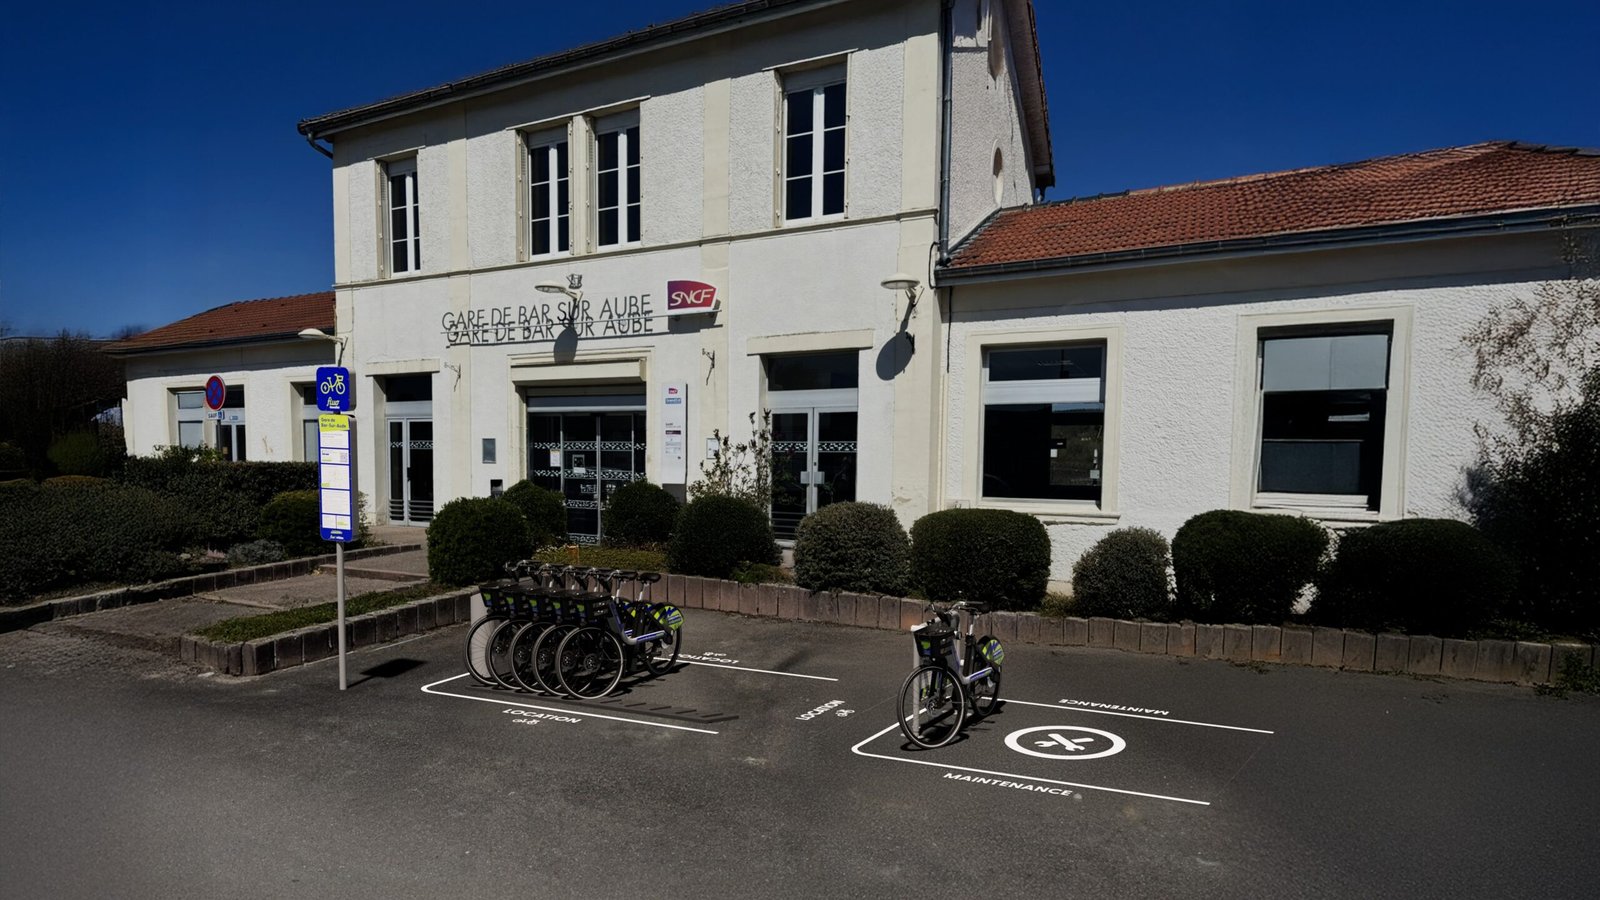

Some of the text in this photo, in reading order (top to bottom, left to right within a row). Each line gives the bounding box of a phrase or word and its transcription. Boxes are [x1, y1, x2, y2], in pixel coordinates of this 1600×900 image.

[670, 288, 714, 306] SNCF
[441, 293, 651, 331] GARE DE BAR SUR AUBE
[502, 708, 581, 724] LOCATION
[1059, 699, 1169, 715] MAINTENANCE
[943, 773, 1073, 796] MAINTENANCE
